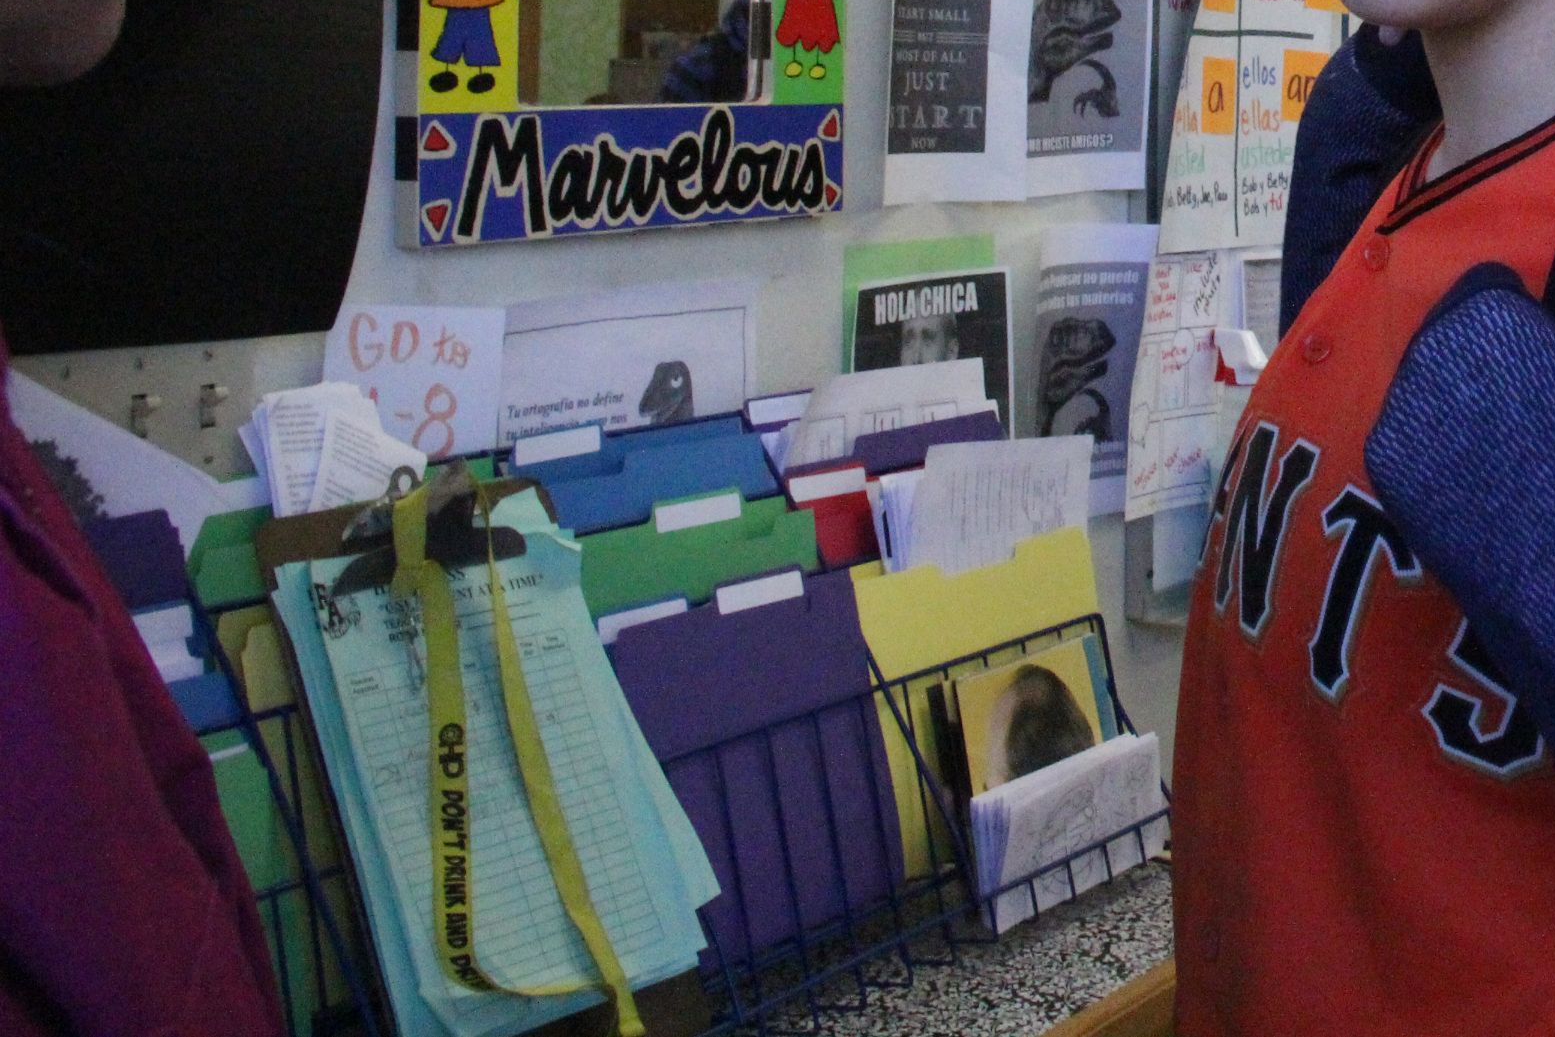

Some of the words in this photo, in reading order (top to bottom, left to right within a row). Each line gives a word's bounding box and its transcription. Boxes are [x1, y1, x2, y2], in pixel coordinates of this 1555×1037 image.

[928, 8, 971, 23] SMALL
[922, 50, 937, 62] OF
[940, 51, 967, 64] ALL
[1243, 55, 1277, 89] ellos
[903, 71, 950, 96] JUST
[1208, 80, 1225, 114] a
[889, 104, 983, 130] START
[1241, 99, 1280, 136] ellas
[911, 137, 937, 149] NOW
[1070, 133, 1114, 148] AMIGOS?
[457, 109, 826, 237] Marvelous
[874, 290, 918, 326] HOLA
[919, 282, 978, 316] CHICA
[592, 392, 625, 408] define
[1200, 416, 1546, 779] NTS
[441, 789, 468, 851] DON'T
[443, 855, 467, 909] DRINK
[445, 912, 469, 950] AND
